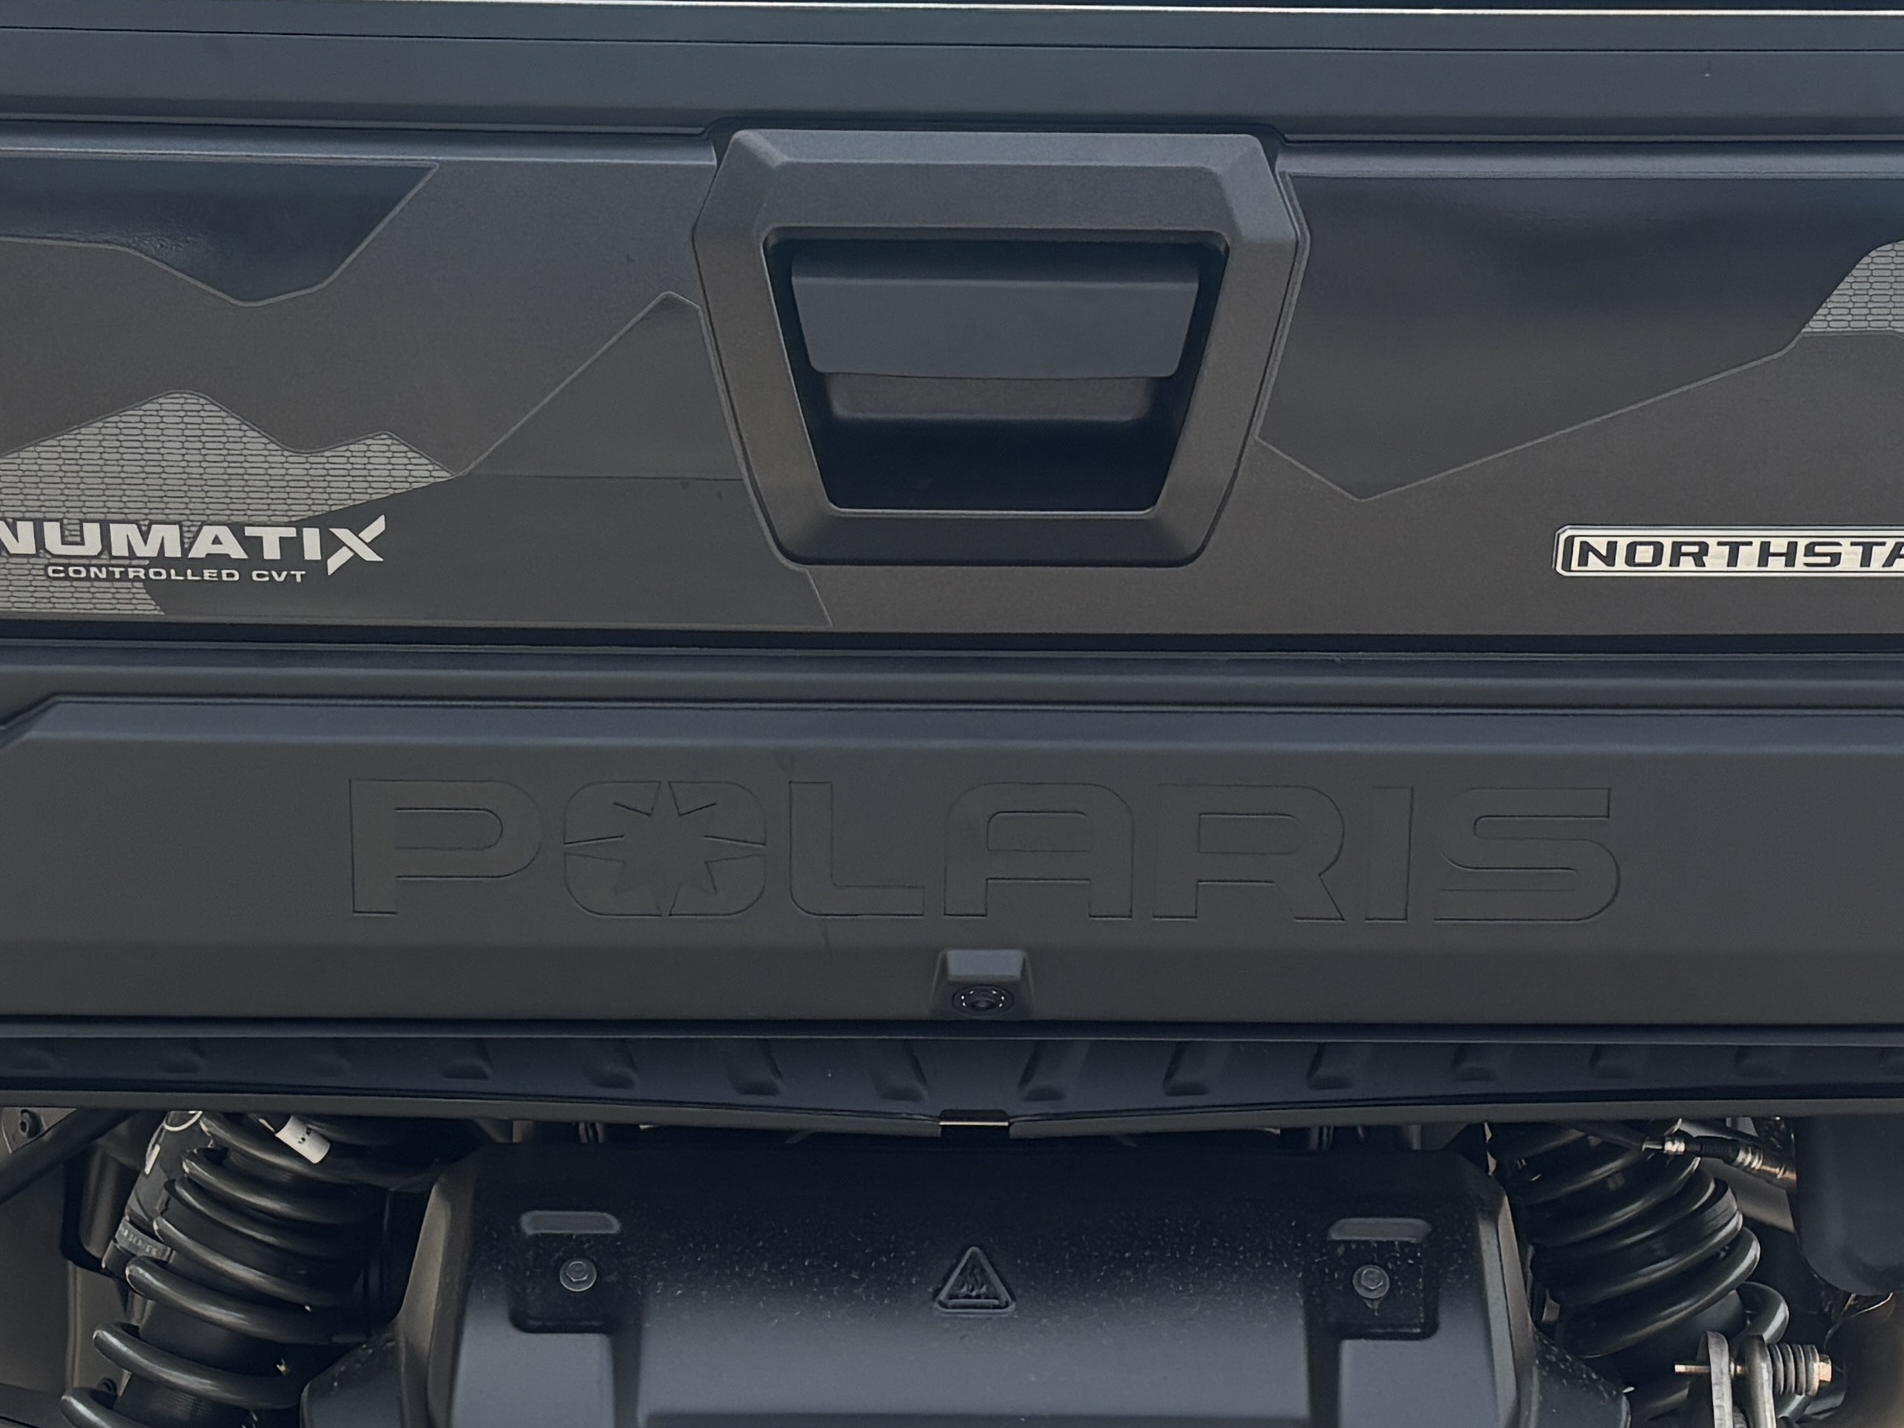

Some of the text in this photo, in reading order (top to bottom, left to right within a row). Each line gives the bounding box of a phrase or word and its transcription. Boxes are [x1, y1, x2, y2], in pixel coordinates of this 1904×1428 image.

[47, 565, 307, 583] CONTROLLED CVT
[349, 778, 1622, 923] POLARIS
